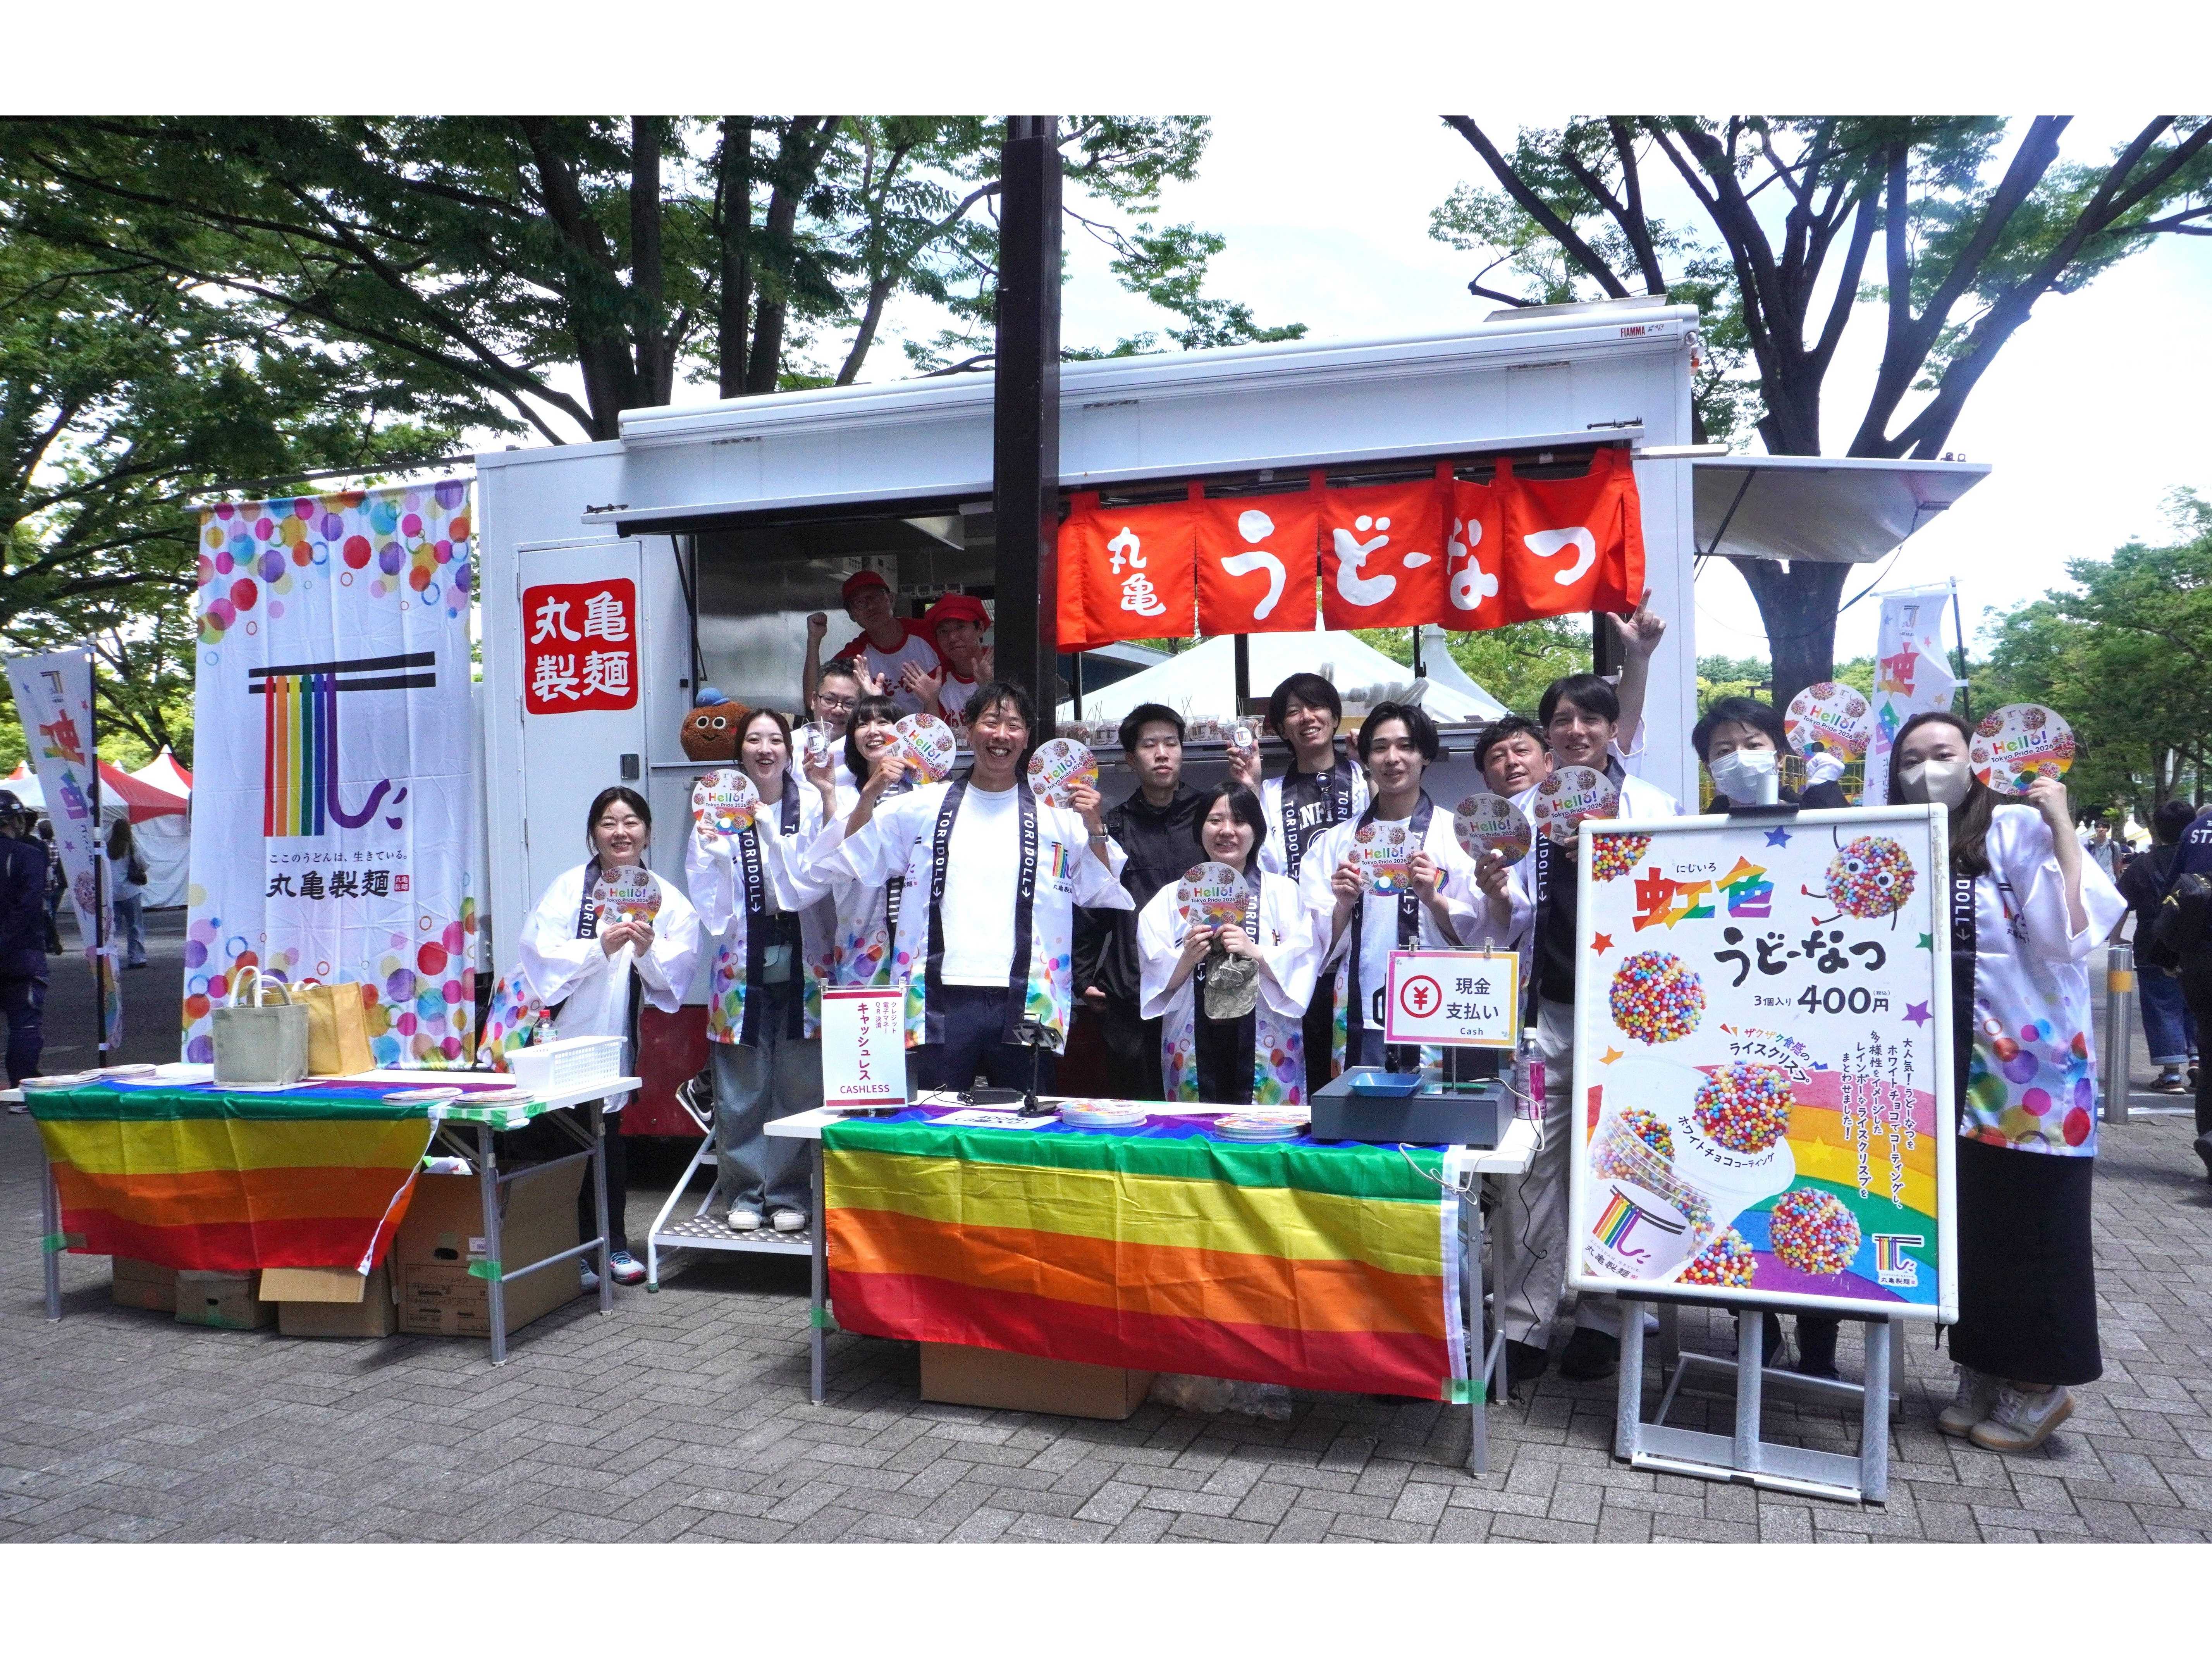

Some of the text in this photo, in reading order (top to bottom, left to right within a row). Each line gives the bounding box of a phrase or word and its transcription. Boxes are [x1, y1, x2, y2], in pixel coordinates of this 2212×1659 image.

[1620, 326, 1645, 337] FIAMMA
[1107, 526, 1166, 617] 丸亀
[530, 591, 630, 644] 丸亀
[532, 650, 630, 702] 製麺
[1804, 715, 1853, 739] Tokyo Pride 2026
[1810, 705, 1856, 731] Hello!
[902, 735, 935, 767] Tokyo Pride 2026
[908, 730, 941, 761] Hello!
[1991, 743, 2054, 763] Tokyo Pride 2026
[1992, 731, 2047, 755] Hello!
[1043, 755, 1077, 784] Hello!
[1048, 762, 1082, 790] Tokyo Pride 2026
[709, 793, 744, 802] Hello!
[1552, 791, 1597, 811] Hello!
[1284, 800, 1300, 871] TORIDOLL
[1469, 819, 1511, 832] Hello!
[269, 850, 408, 863] ここのうどんは、生きている。
[932, 810, 953, 888] TORIDOLL
[1022, 812, 1035, 886] TORIDOLL
[1364, 847, 1403, 859] Hello!
[743, 830, 760, 902] TORIDOLL
[1676, 862, 1717, 873] にじいろ
[265, 869, 390, 900] 丸亀製麺
[610, 888, 646, 897] Hello!
[1194, 886, 1232, 897] Hello!
[1632, 855, 1774, 932] 虹色
[1714, 926, 1887, 988] うどーなつ
[1455, 978, 1491, 995] 現金
[1753, 984, 1890, 1015] 3個入り 400円
[1445, 1002, 1499, 1021] 支払い
[857, 1003, 870, 1080] キャッシュレス
[1460, 1027, 1484, 1036] Cash
[1744, 1028, 1810, 1061] ザクザク食感の
[1730, 1041, 1810, 1083] ライスクリスプ
[840, 1084, 890, 1094] CASHLESS
[1869, 1030, 1885, 1134] 多様性をイメージした
[1856, 1042, 1871, 1198] レインボーなライスクリスプを
